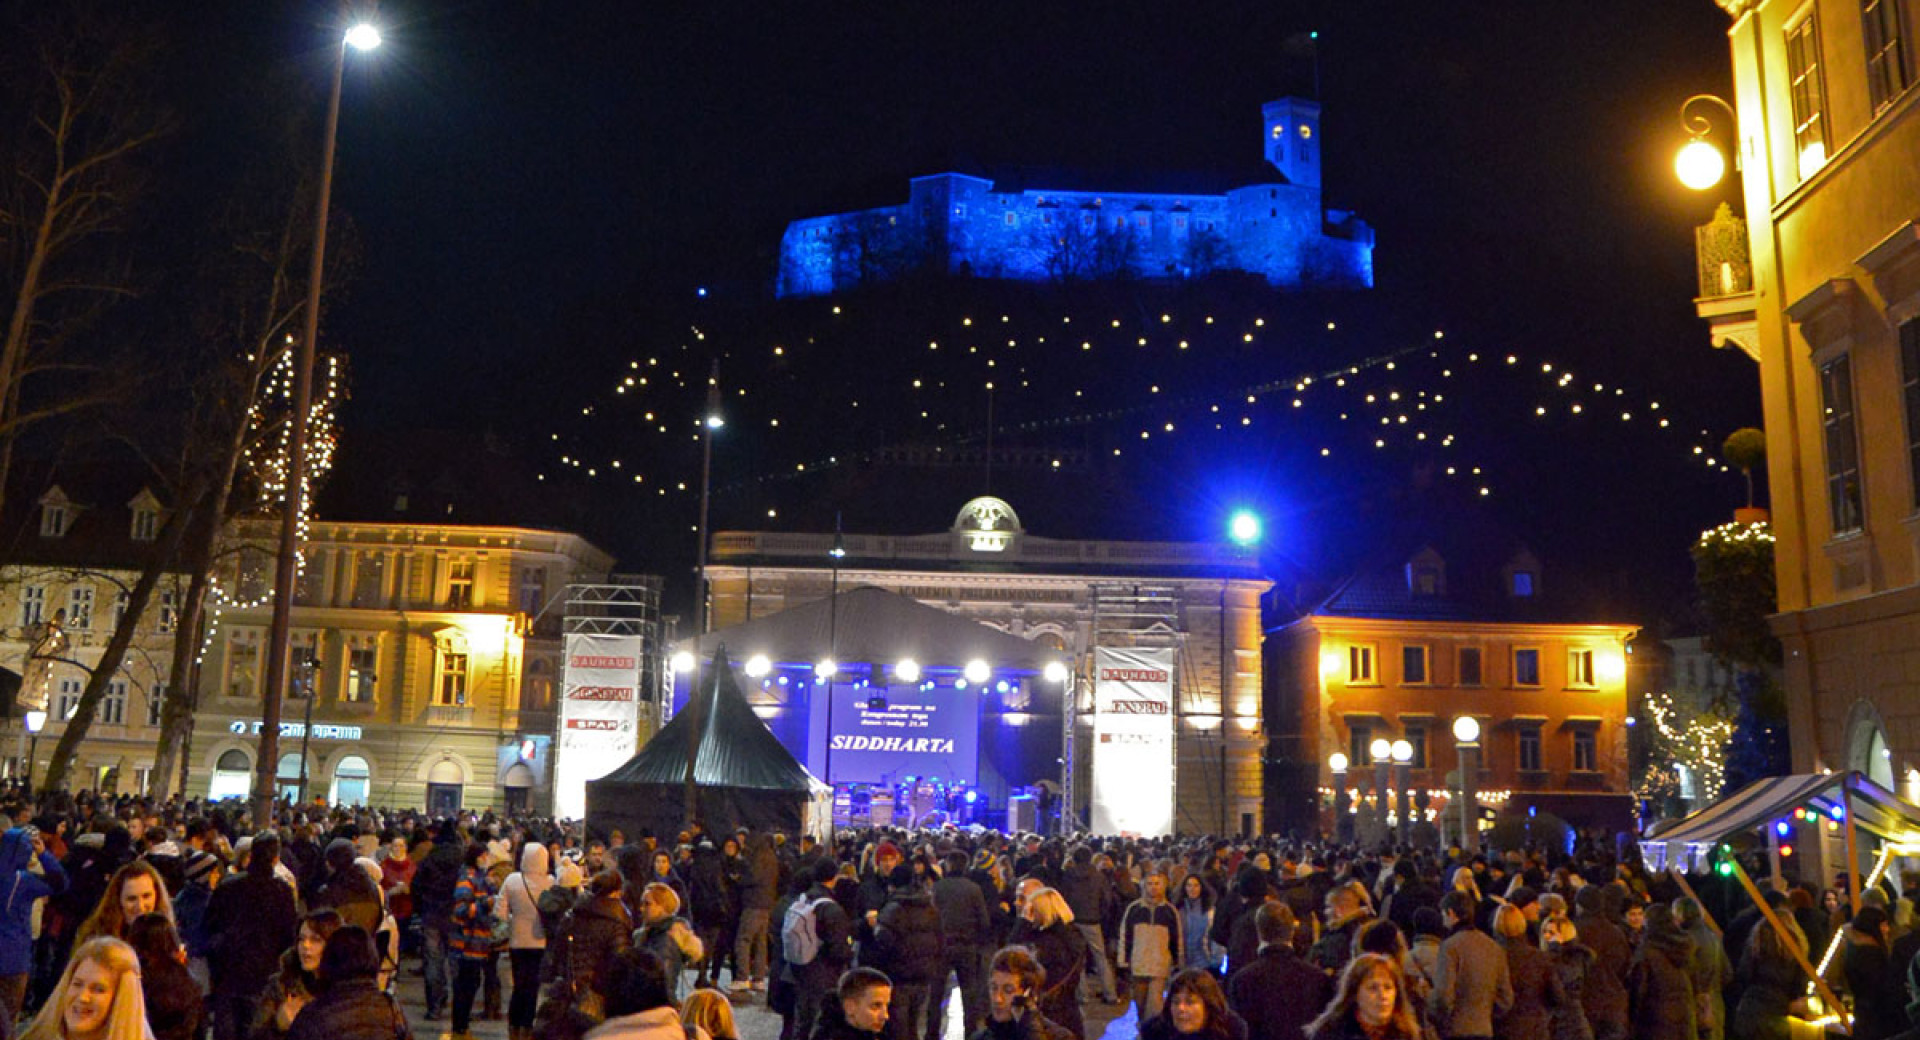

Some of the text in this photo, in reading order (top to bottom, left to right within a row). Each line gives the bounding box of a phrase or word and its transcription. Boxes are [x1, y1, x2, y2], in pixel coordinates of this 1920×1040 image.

[1102, 670, 1167, 682] BAUHAUS
[577, 720, 617, 730] SPAR
[830, 735, 954, 753] SIDDHARTA
